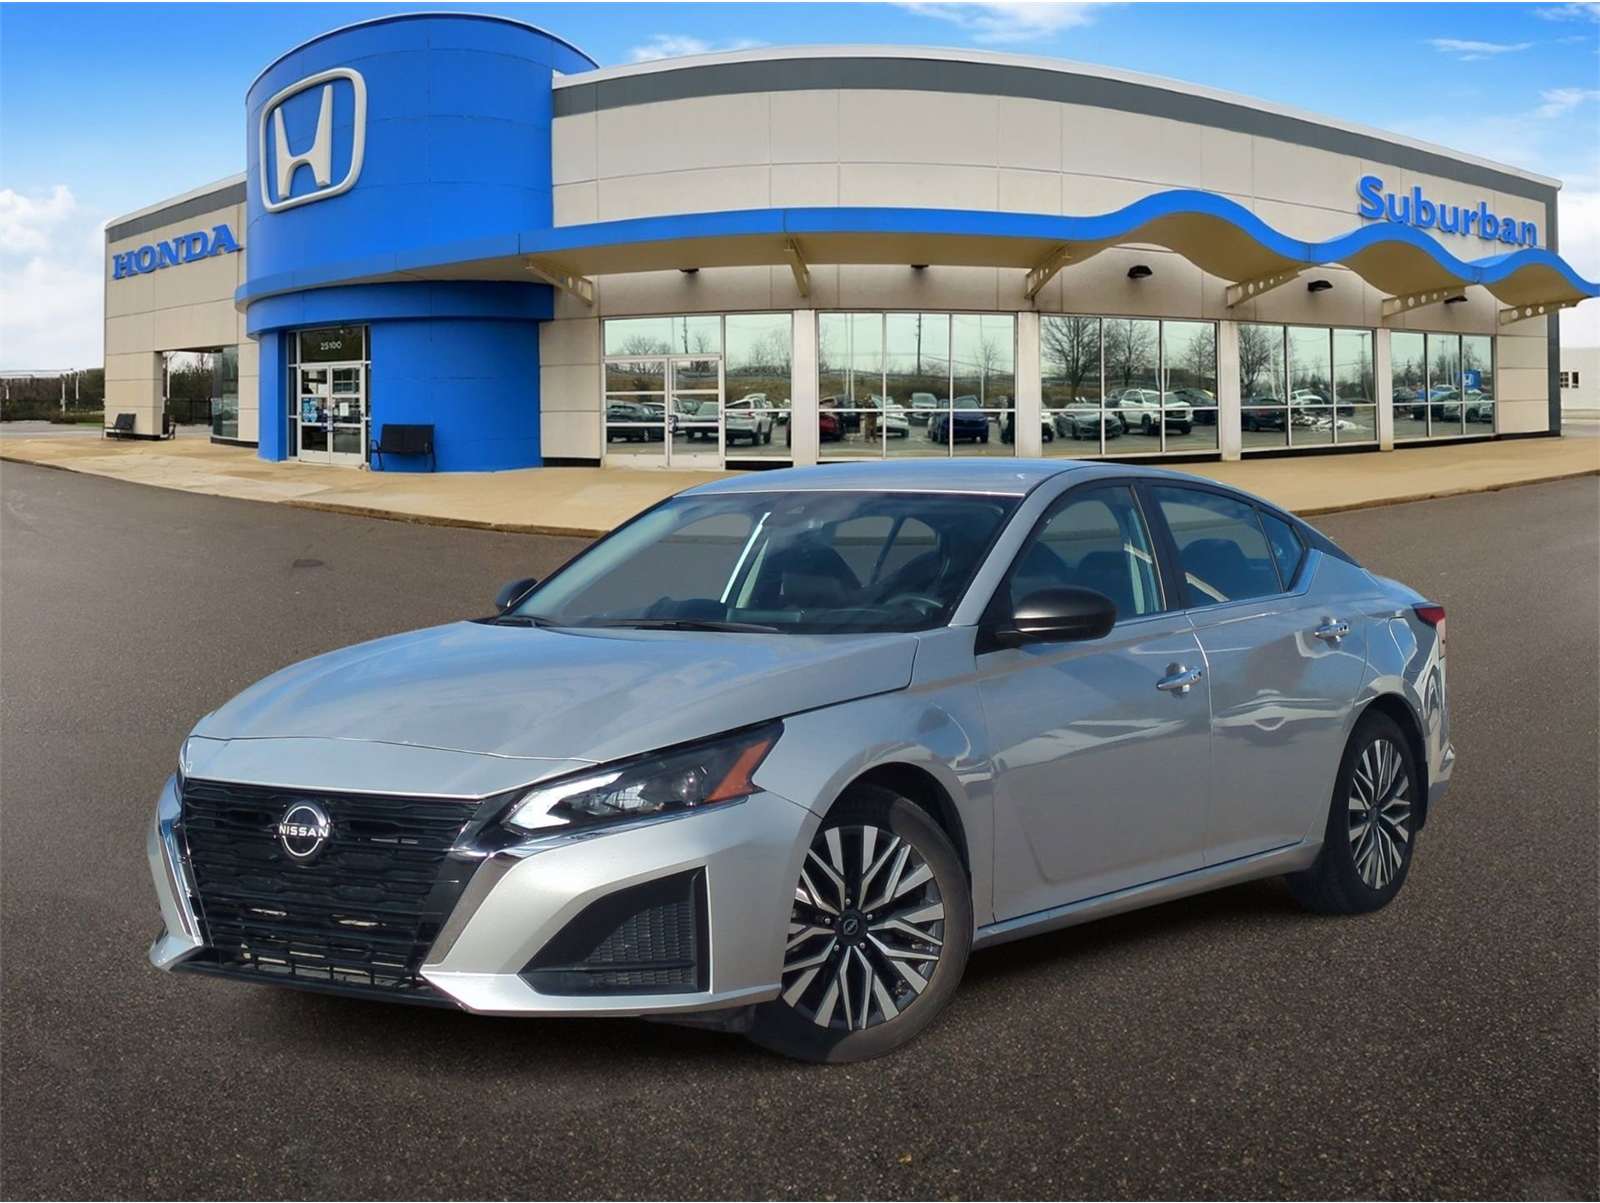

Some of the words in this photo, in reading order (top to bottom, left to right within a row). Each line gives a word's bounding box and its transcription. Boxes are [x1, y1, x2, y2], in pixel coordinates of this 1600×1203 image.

[1357, 176, 1537, 247] Suburban
[112, 224, 240, 279] HONDA
[320, 340, 342, 351] 25100
[279, 824, 329, 838] NISSAN
